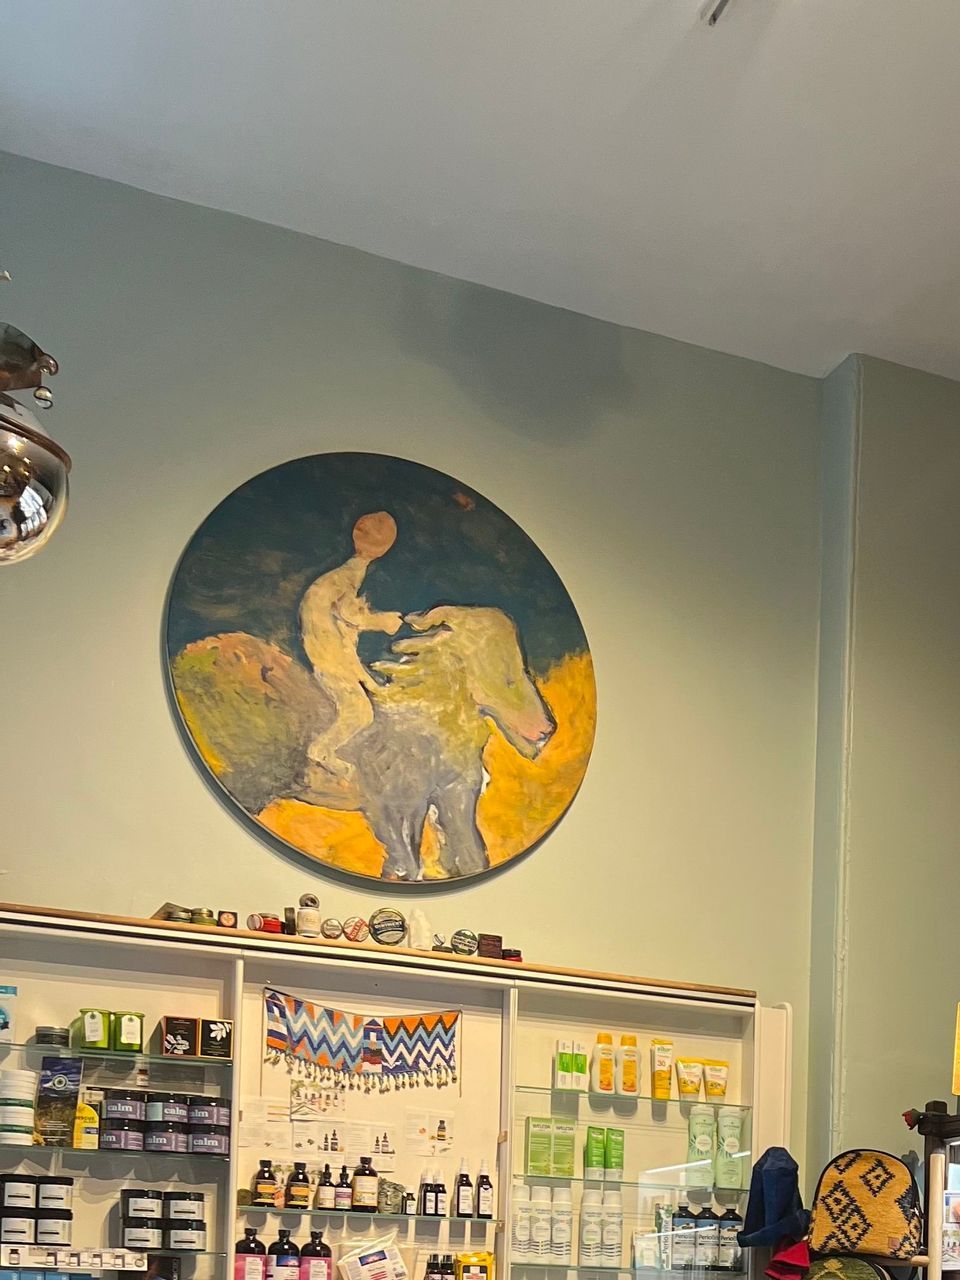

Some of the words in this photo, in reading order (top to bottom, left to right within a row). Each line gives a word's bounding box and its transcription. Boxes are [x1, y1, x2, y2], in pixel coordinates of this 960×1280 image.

[107, 1103, 133, 1112] calm
[164, 1106, 187, 1115] calm
[190, 1109, 209, 1118] alm
[100, 1133, 117, 1142] alm
[146, 1135, 167, 1144] alm
[193, 1138, 219, 1147] calm
